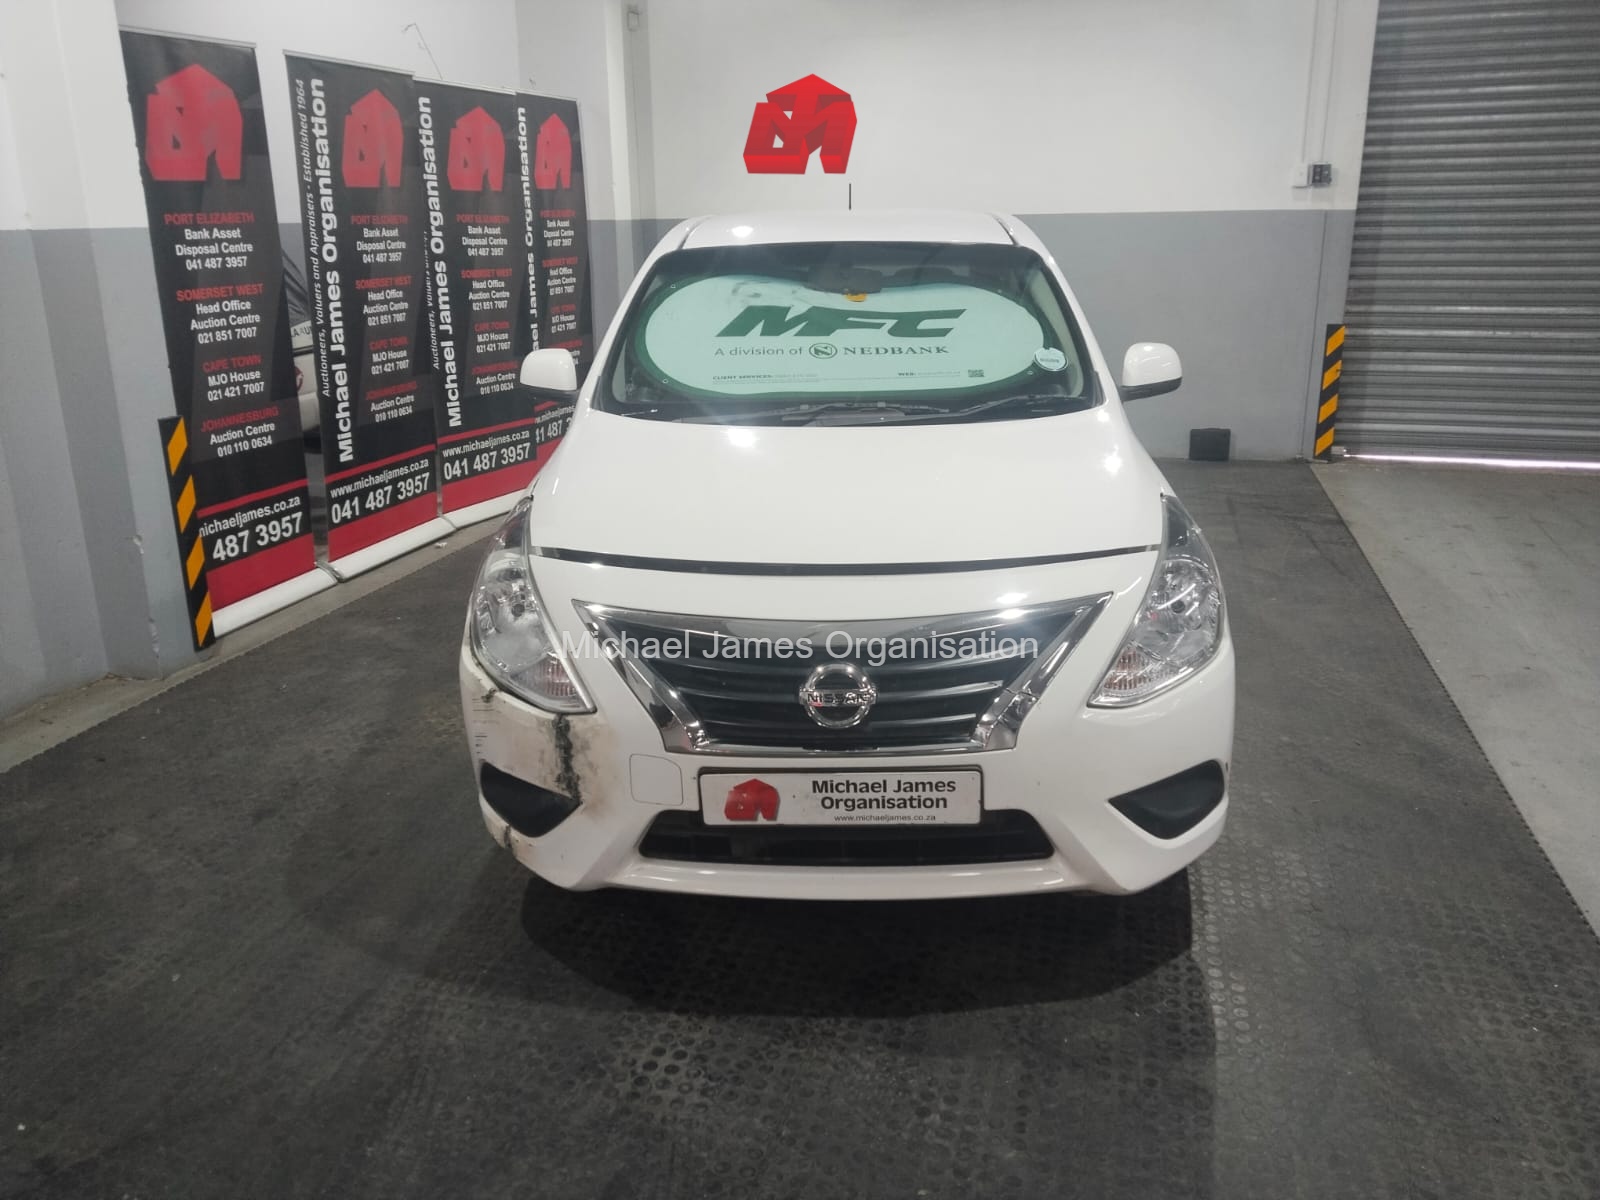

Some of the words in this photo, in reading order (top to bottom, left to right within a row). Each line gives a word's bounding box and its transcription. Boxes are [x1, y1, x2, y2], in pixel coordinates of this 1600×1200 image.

[295, 78, 307, 109] 1964
[297, 112, 312, 182] Established
[310, 78, 338, 263] Organisation
[418, 96, 444, 254] Organisation
[517, 107, 533, 247] Organisation
[164, 213, 194, 225] PORT
[196, 211, 255, 224] ELIZABETH
[306, 192, 319, 255] Appraisers
[184, 228, 210, 240] Bank
[212, 227, 242, 239] Asset
[363, 227, 381, 238] Bank
[381, 227, 399, 237] Asset
[488, 236, 508, 245] Centre
[175, 243, 219, 257] Disposal
[221, 242, 253, 253] Centre
[356, 240, 386, 252] Disposal
[386, 239, 407, 250] Centre
[185, 259, 202, 271] 041
[204, 257, 222, 269] 487
[225, 256, 247, 268] 3957
[362, 253, 375, 263] 041
[375, 252, 387, 262] 487
[388, 252, 402, 262] 3957
[310, 256, 321, 280] and
[176, 286, 234, 301] SOMERSET
[236, 283, 263, 295] WEST
[487, 279, 505, 288] Office
[527, 252, 538, 318] James
[314, 282, 324, 325] Valuers
[367, 290, 384, 301] Head
[385, 289, 403, 299] Office
[434, 260, 453, 335] James
[468, 291, 490, 300] Auction
[491, 290, 510, 299] Centre
[195, 302, 219, 315] Head
[221, 300, 252, 312] Office
[326, 270, 346, 356] James
[363, 303, 388, 314] Auction
[389, 301, 408, 311] Centre
[190, 317, 227, 330] Auction
[229, 313, 260, 326] Centre
[367, 316, 379, 326] 021
[715, 305, 968, 337] MFC
[197, 332, 213, 344] 021
[215, 329, 232, 341] 851
[235, 326, 257, 339] 7007
[428, 310, 440, 370] Auctioneers,
[489, 332, 508, 341] House
[372, 351, 387, 362] MJO
[387, 350, 407, 360] House
[713, 347, 725, 356] A
[729, 346, 785, 356] division
[789, 346, 803, 355] of
[843, 345, 950, 355] NEDBANK
[202, 359, 228, 373] CAPE
[232, 354, 262, 368] TOWN
[318, 328, 331, 397] Auctioneers,
[371, 365, 382, 375] 021
[384, 361, 395, 372] 421
[207, 373, 228, 387] MJO
[229, 370, 261, 383] House
[440, 340, 462, 427] Michael
[476, 375, 497, 384] Auction
[497, 372, 516, 381] Centre
[207, 389, 223, 402] 021
[224, 385, 241, 397] 421
[243, 381, 265, 394] 7007
[331, 362, 354, 463] Michael
[371, 399, 395, 412] Auction
[395, 395, 415, 405] Centre
[398, 405, 413, 416] 0634
[201, 405, 279, 433] JOHANNESBURG
[209, 429, 244, 445] Auction
[245, 422, 275, 436] Centre
[547, 419, 563, 438] 487
[217, 444, 232, 458] 010
[234, 440, 249, 453] 110
[251, 435, 272, 449] 0634
[442, 430, 530, 458] www.michaeljames.co.za
[443, 458, 468, 480] 041
[473, 450, 497, 472] 487
[500, 442, 531, 465] 3957
[329, 458, 429, 498] www.michaeljames.co.za
[331, 496, 360, 524] 041
[365, 485, 393, 511] 487
[396, 471, 430, 500] 3957
[212, 529, 249, 561] 487
[255, 511, 303, 546] 3957
[812, 779, 887, 793] Michael
[893, 779, 956, 793] James
[820, 795, 948, 812] Organisation
[834, 814, 936, 823] www.michaeljames.co.za
